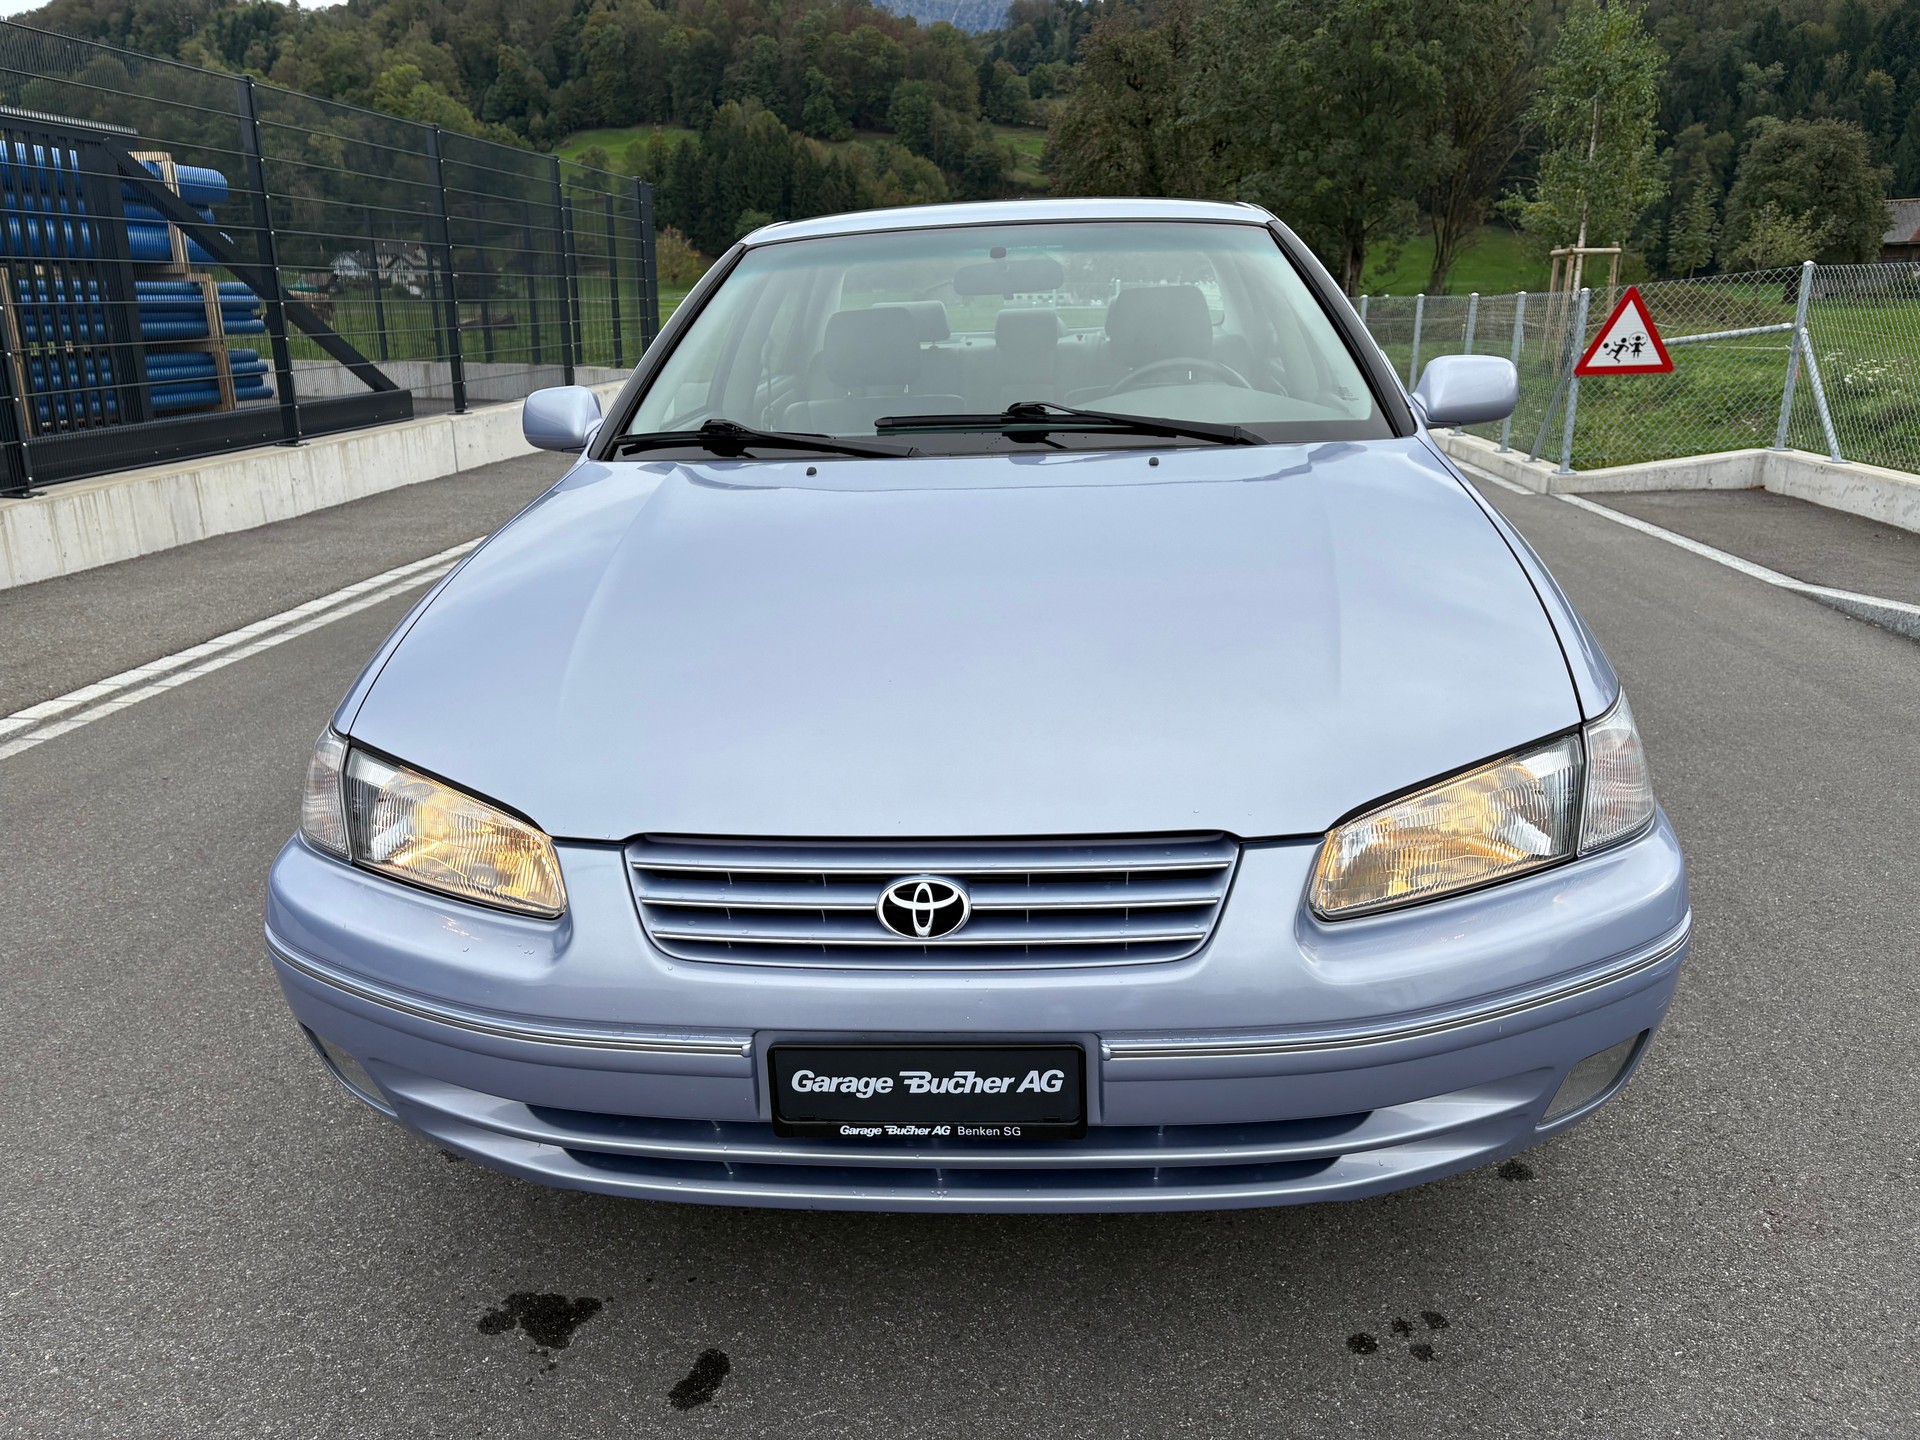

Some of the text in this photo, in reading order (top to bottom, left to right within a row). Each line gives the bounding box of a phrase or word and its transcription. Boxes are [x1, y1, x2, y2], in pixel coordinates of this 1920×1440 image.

[791, 1069, 1065, 1099] Garage Bucher AG
[839, 1125, 1021, 1137] Garage Bucher AG Benken SG
